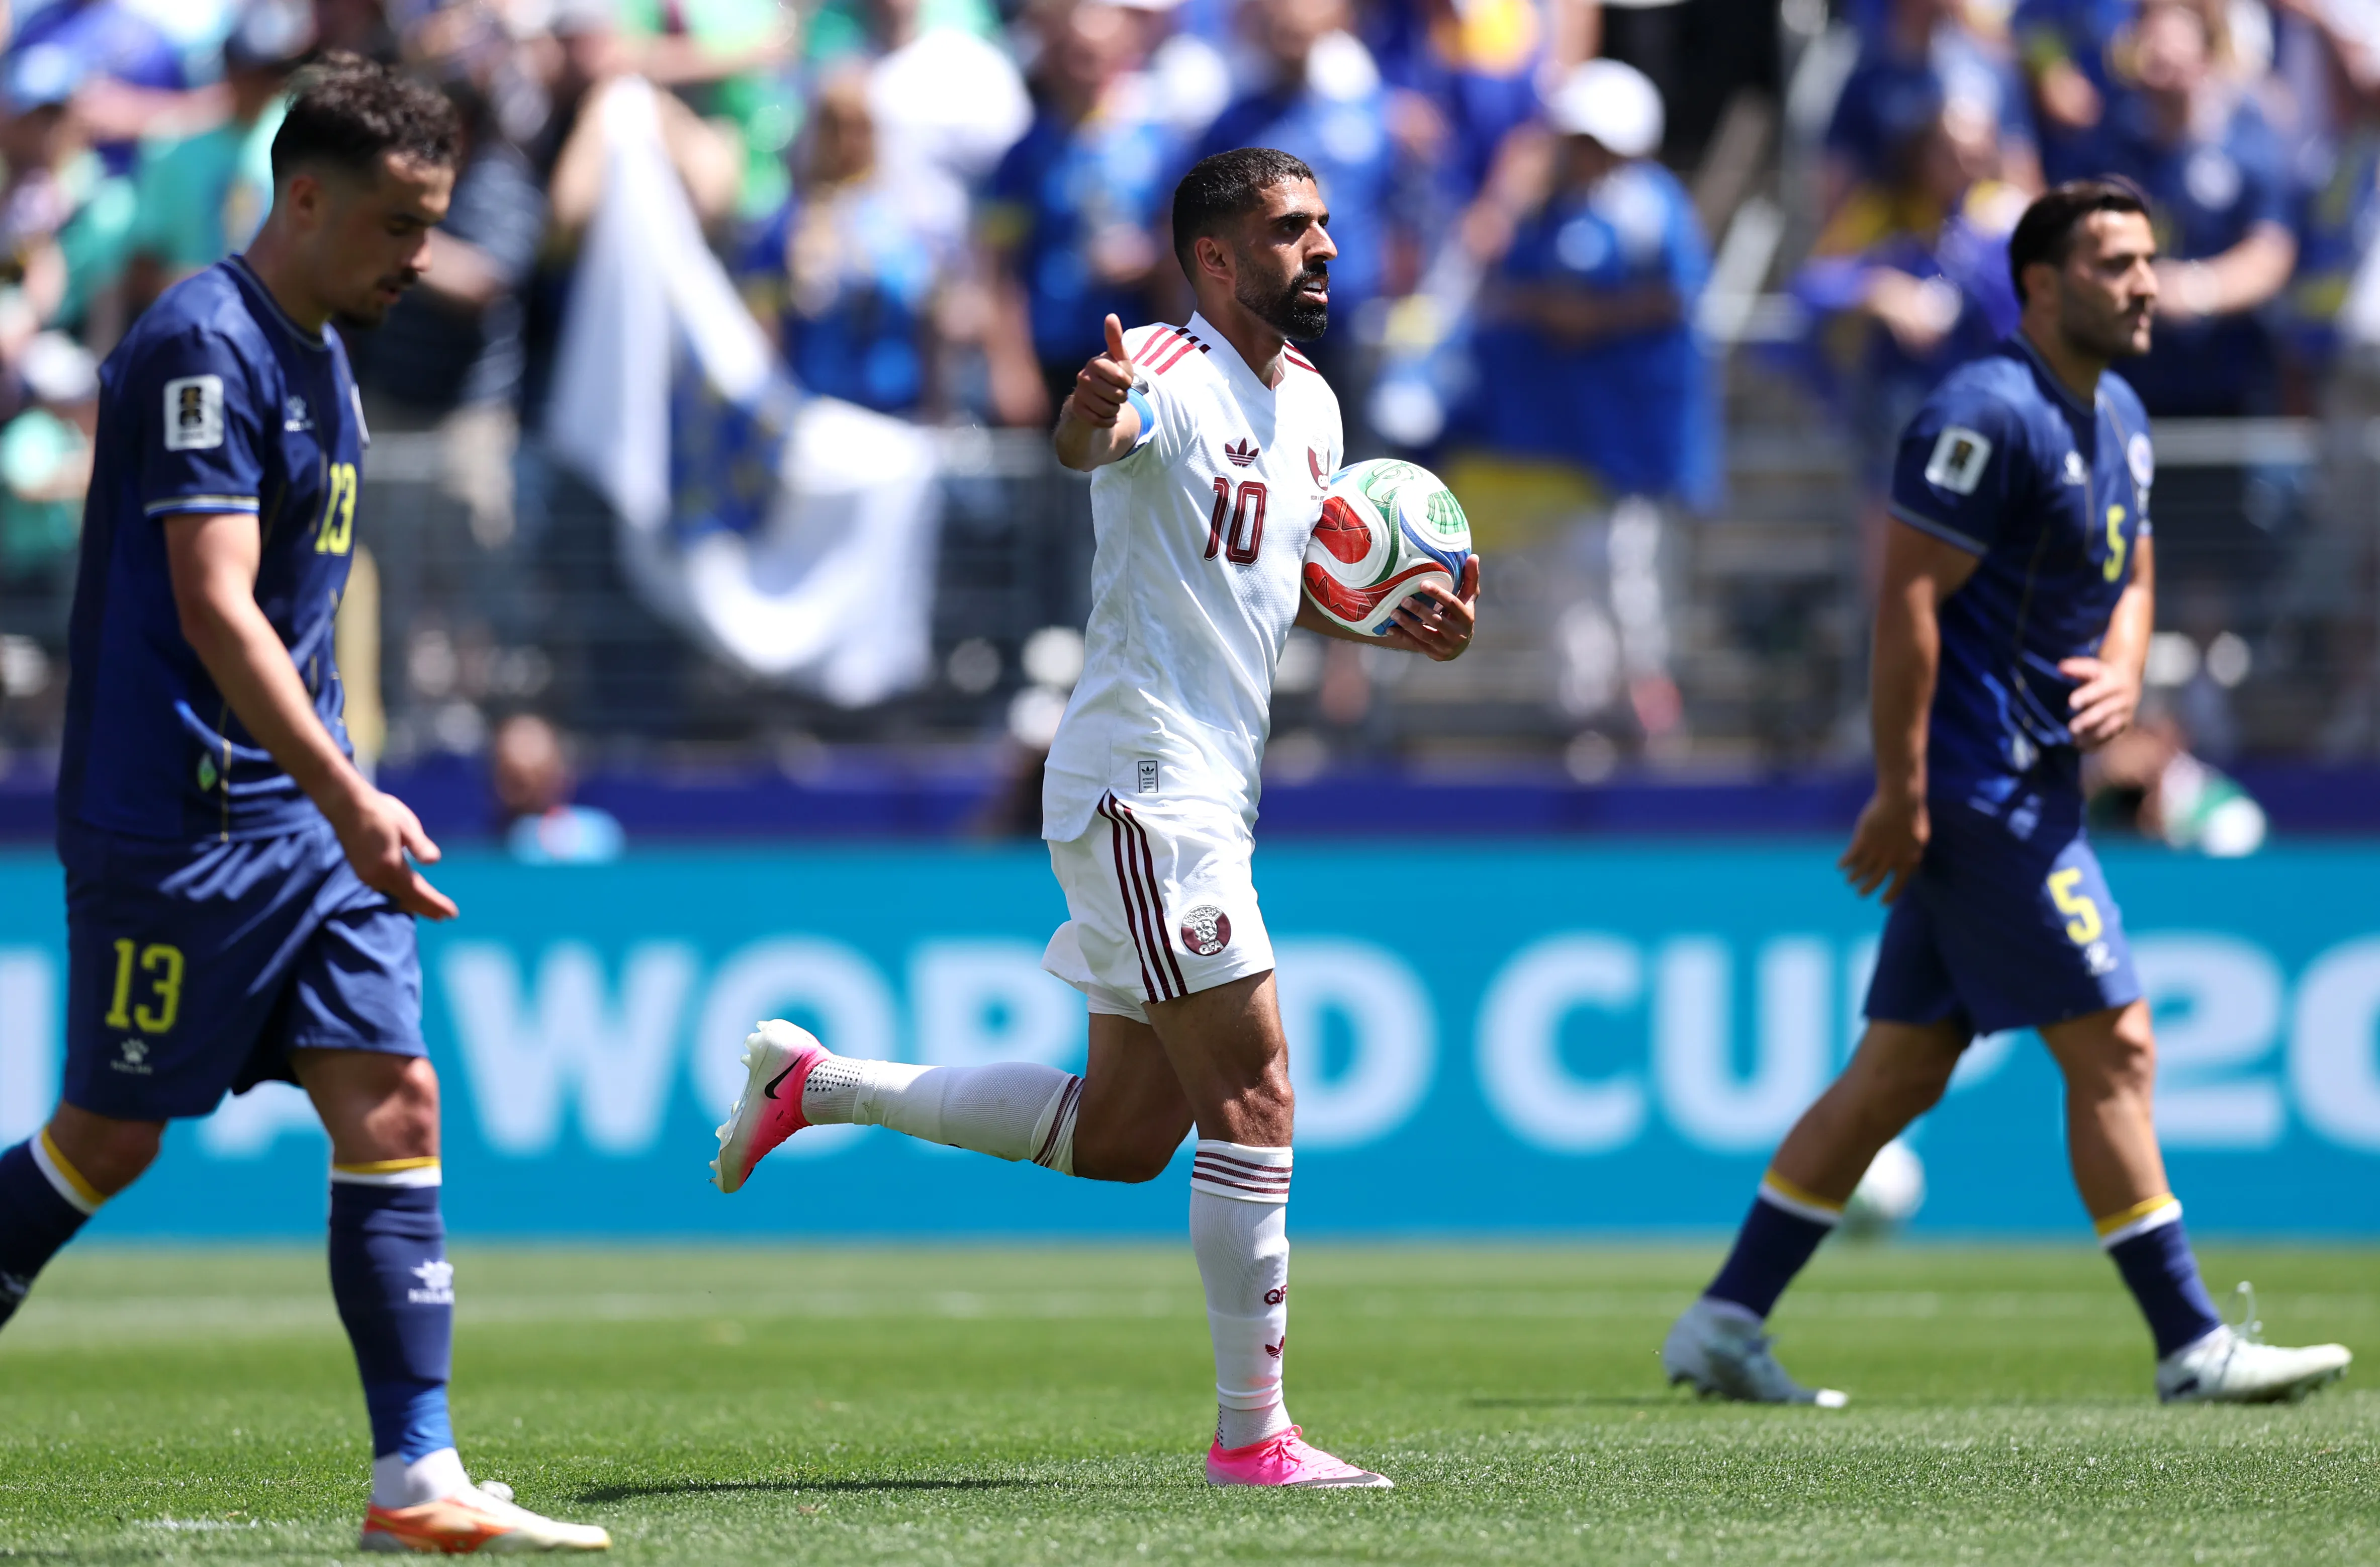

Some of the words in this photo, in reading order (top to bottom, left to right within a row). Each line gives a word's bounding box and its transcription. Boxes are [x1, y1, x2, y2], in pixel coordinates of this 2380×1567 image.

[315, 462, 357, 556] 13
[1204, 477, 1268, 567] 10
[2102, 503, 2126, 583] 5
[1199, 939, 1224, 955] QFA
[2047, 866, 2102, 945] 5
[105, 938, 185, 1033] 13
[442, 934, 1433, 1153] WORD
[1477, 933, 2016, 1153] CU
